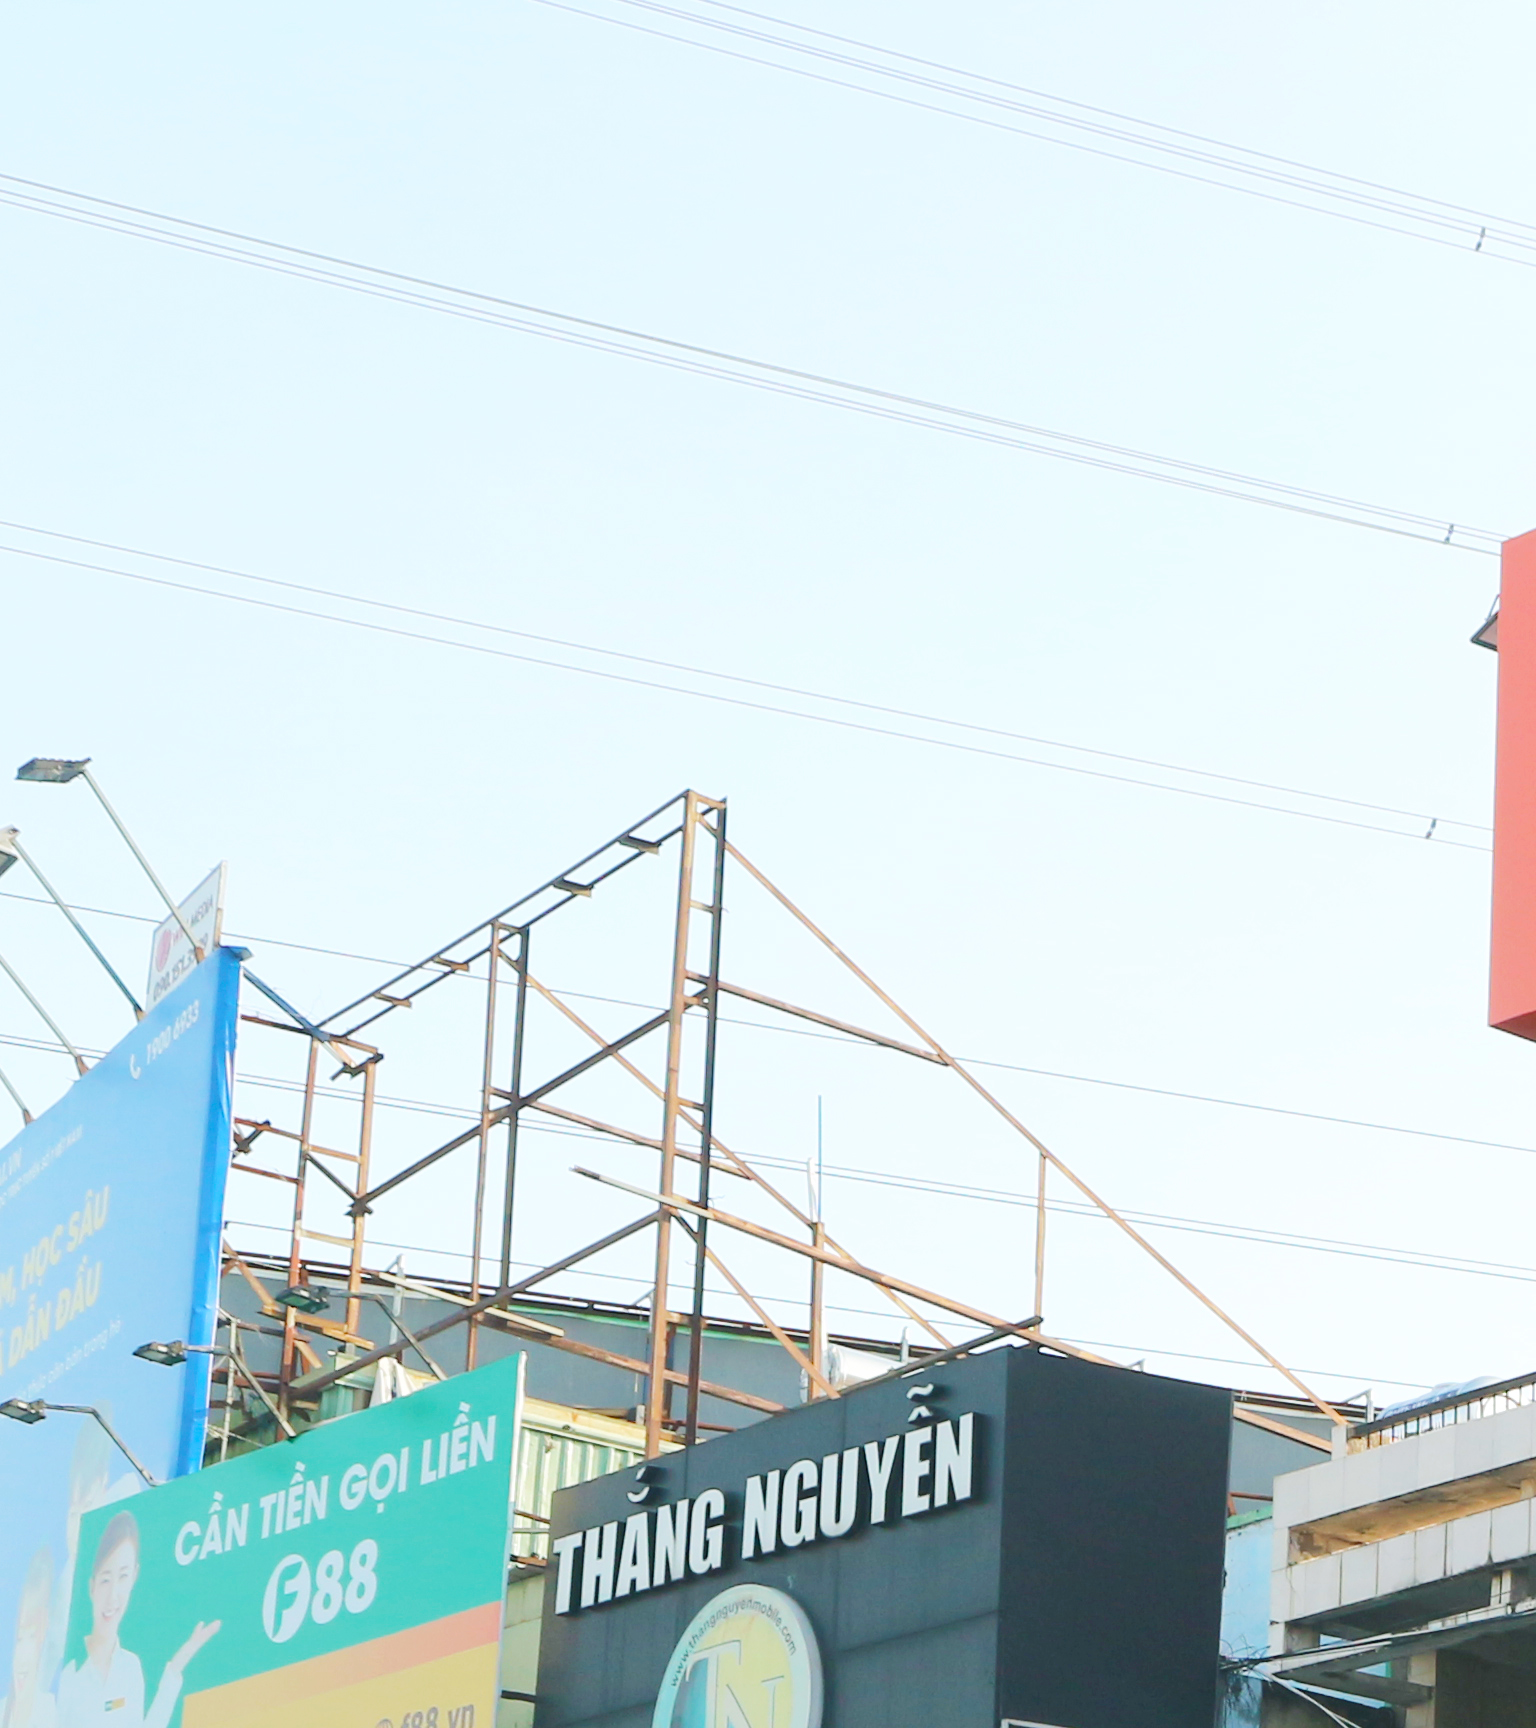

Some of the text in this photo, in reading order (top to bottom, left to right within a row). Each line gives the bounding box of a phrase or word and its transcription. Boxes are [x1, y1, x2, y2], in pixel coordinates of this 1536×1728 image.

[173, 1401, 497, 1567] CẦN TIỀN GỌI LIỀN
[552, 1384, 974, 1616] THẮNG NGUYỄN
[262, 1538, 379, 1645] F88
